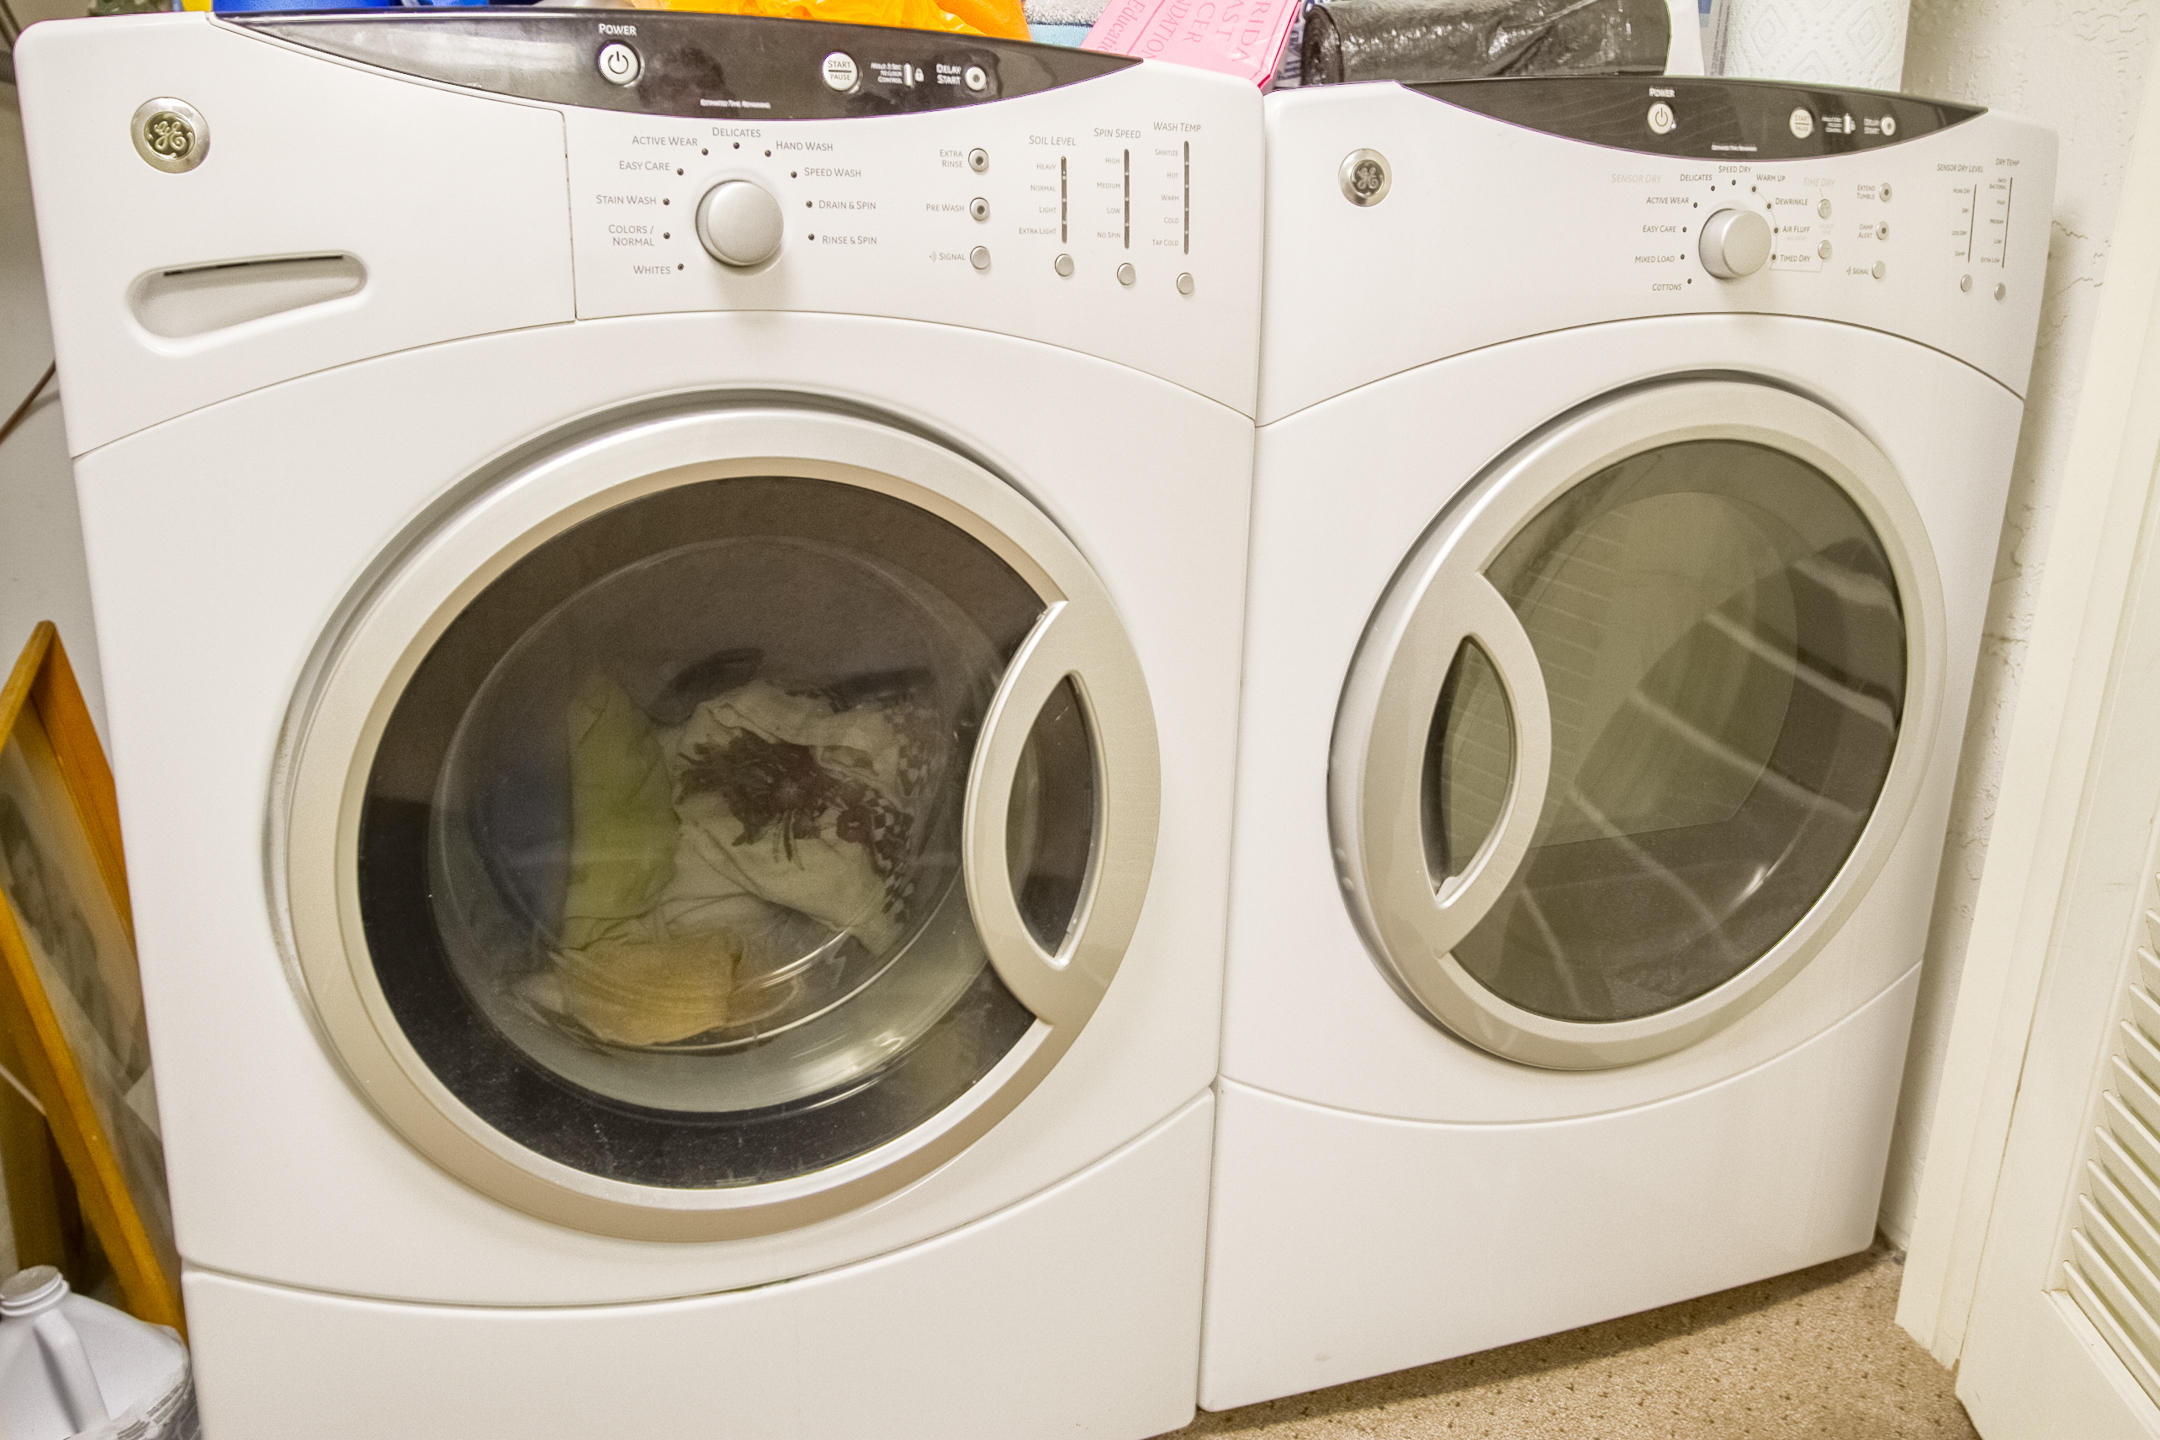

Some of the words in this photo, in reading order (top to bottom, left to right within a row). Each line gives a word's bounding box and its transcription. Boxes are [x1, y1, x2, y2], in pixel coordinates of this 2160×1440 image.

[1183, 2, 1216, 43] CER
[598, 23, 638, 36] POWER
[828, 60, 852, 69] START
[935, 63, 962, 75] DELAY
[936, 74, 962, 85] START
[1648, 87, 1676, 98] POWER
[1153, 121, 1178, 132] WASH
[1180, 122, 1202, 133] TEMP
[712, 127, 761, 138] DELICATES
[1094, 127, 1113, 138] SPIN
[1115, 128, 1142, 139] SPEED
[632, 135, 667, 146] ACTIVE
[668, 136, 698, 147] WEAR
[1028, 134, 1049, 145] SOIL
[1050, 136, 1077, 147] LEVEL
[776, 140, 804, 151] HAND
[805, 141, 833, 152] WASH
[939, 149, 963, 158] EXTRA
[619, 160, 643, 171] EASY
[645, 161, 671, 172] CARE
[942, 160, 963, 168] RINSE
[2006, 158, 2020, 167] TEMP
[804, 168, 833, 178] SPEED
[834, 168, 862, 178] WASH
[1718, 165, 1738, 173] SPEED
[1738, 165, 1751, 174] DRY
[1936, 163, 1957, 172] SENSOR
[1957, 164, 1969, 172] DRY
[1968, 165, 1984, 174] LEVEL
[1680, 173, 1713, 182] DELICATES
[1756, 174, 1776, 183] WARM
[1776, 175, 1786, 183] UP
[596, 195, 625, 205] STAIN
[626, 195, 657, 206] WASH
[818, 199, 848, 210] DRAIN
[849, 201, 855, 210] &
[856, 200, 877, 211] SPIN
[1646, 197, 1669, 205] ACTIVE
[1669, 197, 1690, 205] WEAR
[1775, 197, 1809, 206] DEWRINKLE
[926, 203, 940, 212] PRE
[941, 203, 965, 212] WASH
[608, 224, 647, 235] COLORS
[1018, 227, 1038, 235] EXTRA
[1642, 225, 1659, 233] EASY
[1659, 225, 1676, 233] CARE
[1782, 225, 1793, 233] AIR
[1793, 226, 1811, 234] FLUFF
[822, 235, 849, 245] RINSE
[850, 236, 856, 245] &
[857, 236, 878, 246] SPIN
[1107, 232, 1121, 240] SPIN
[612, 236, 655, 247] NORMAL
[938, 252, 966, 261] SIGNAL
[1634, 255, 1655, 263] MIXED
[1656, 255, 1675, 263] LOAD
[1780, 254, 1798, 263] TIMED
[1798, 255, 1811, 264] DRY
[633, 264, 671, 275] WHITES
[1652, 283, 1682, 292] COTTONS
